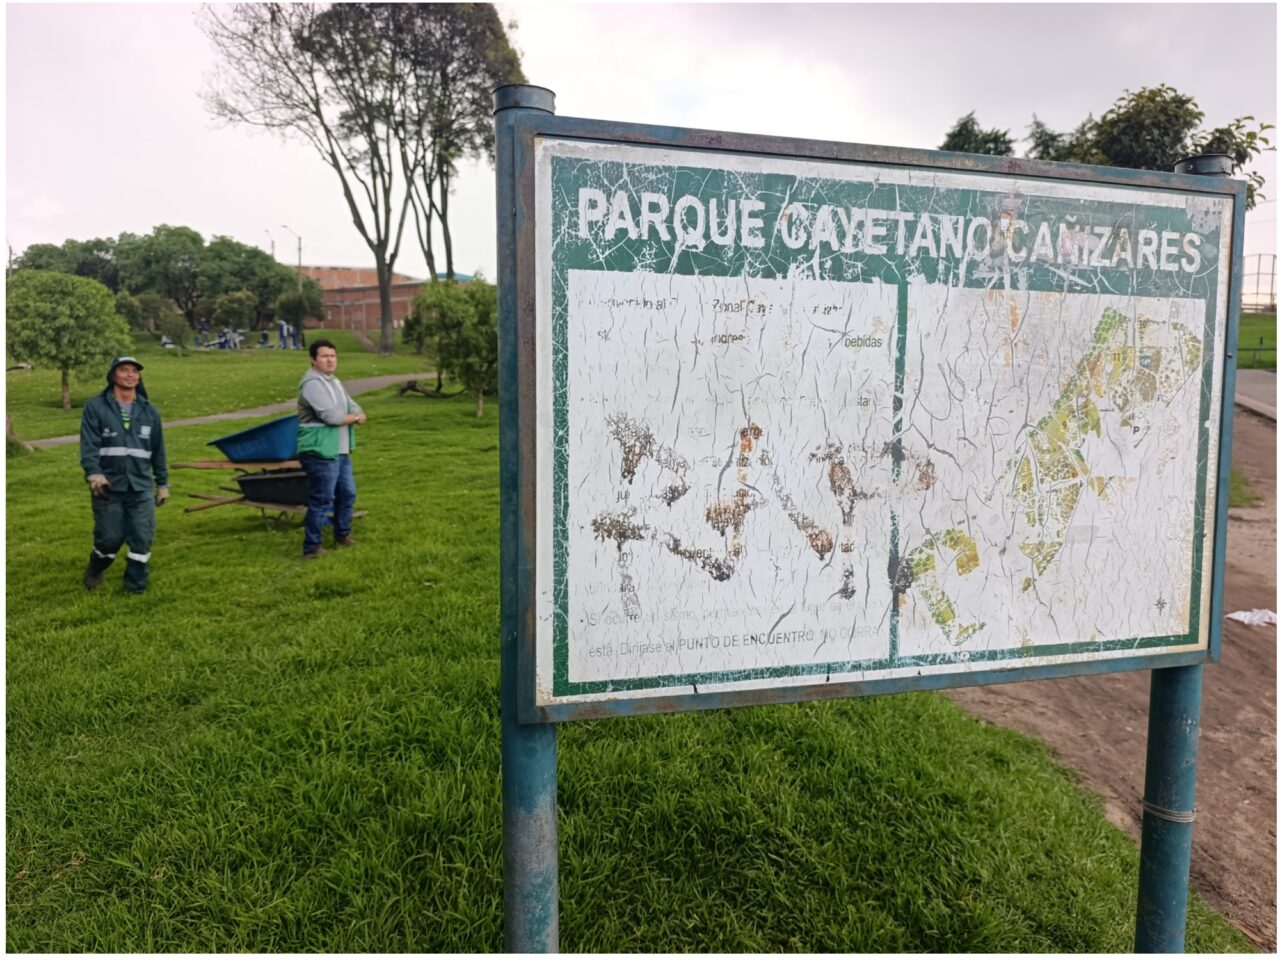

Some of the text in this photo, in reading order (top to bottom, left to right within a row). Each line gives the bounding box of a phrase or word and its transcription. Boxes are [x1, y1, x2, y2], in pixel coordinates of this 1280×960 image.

[578, 187, 1202, 273] PARQUE CAYETANO CAÑIZARES
[678, 636, 720, 651] PUNTO
[723, 634, 740, 648] DE
[743, 628, 814, 647] ENCUENTRO
